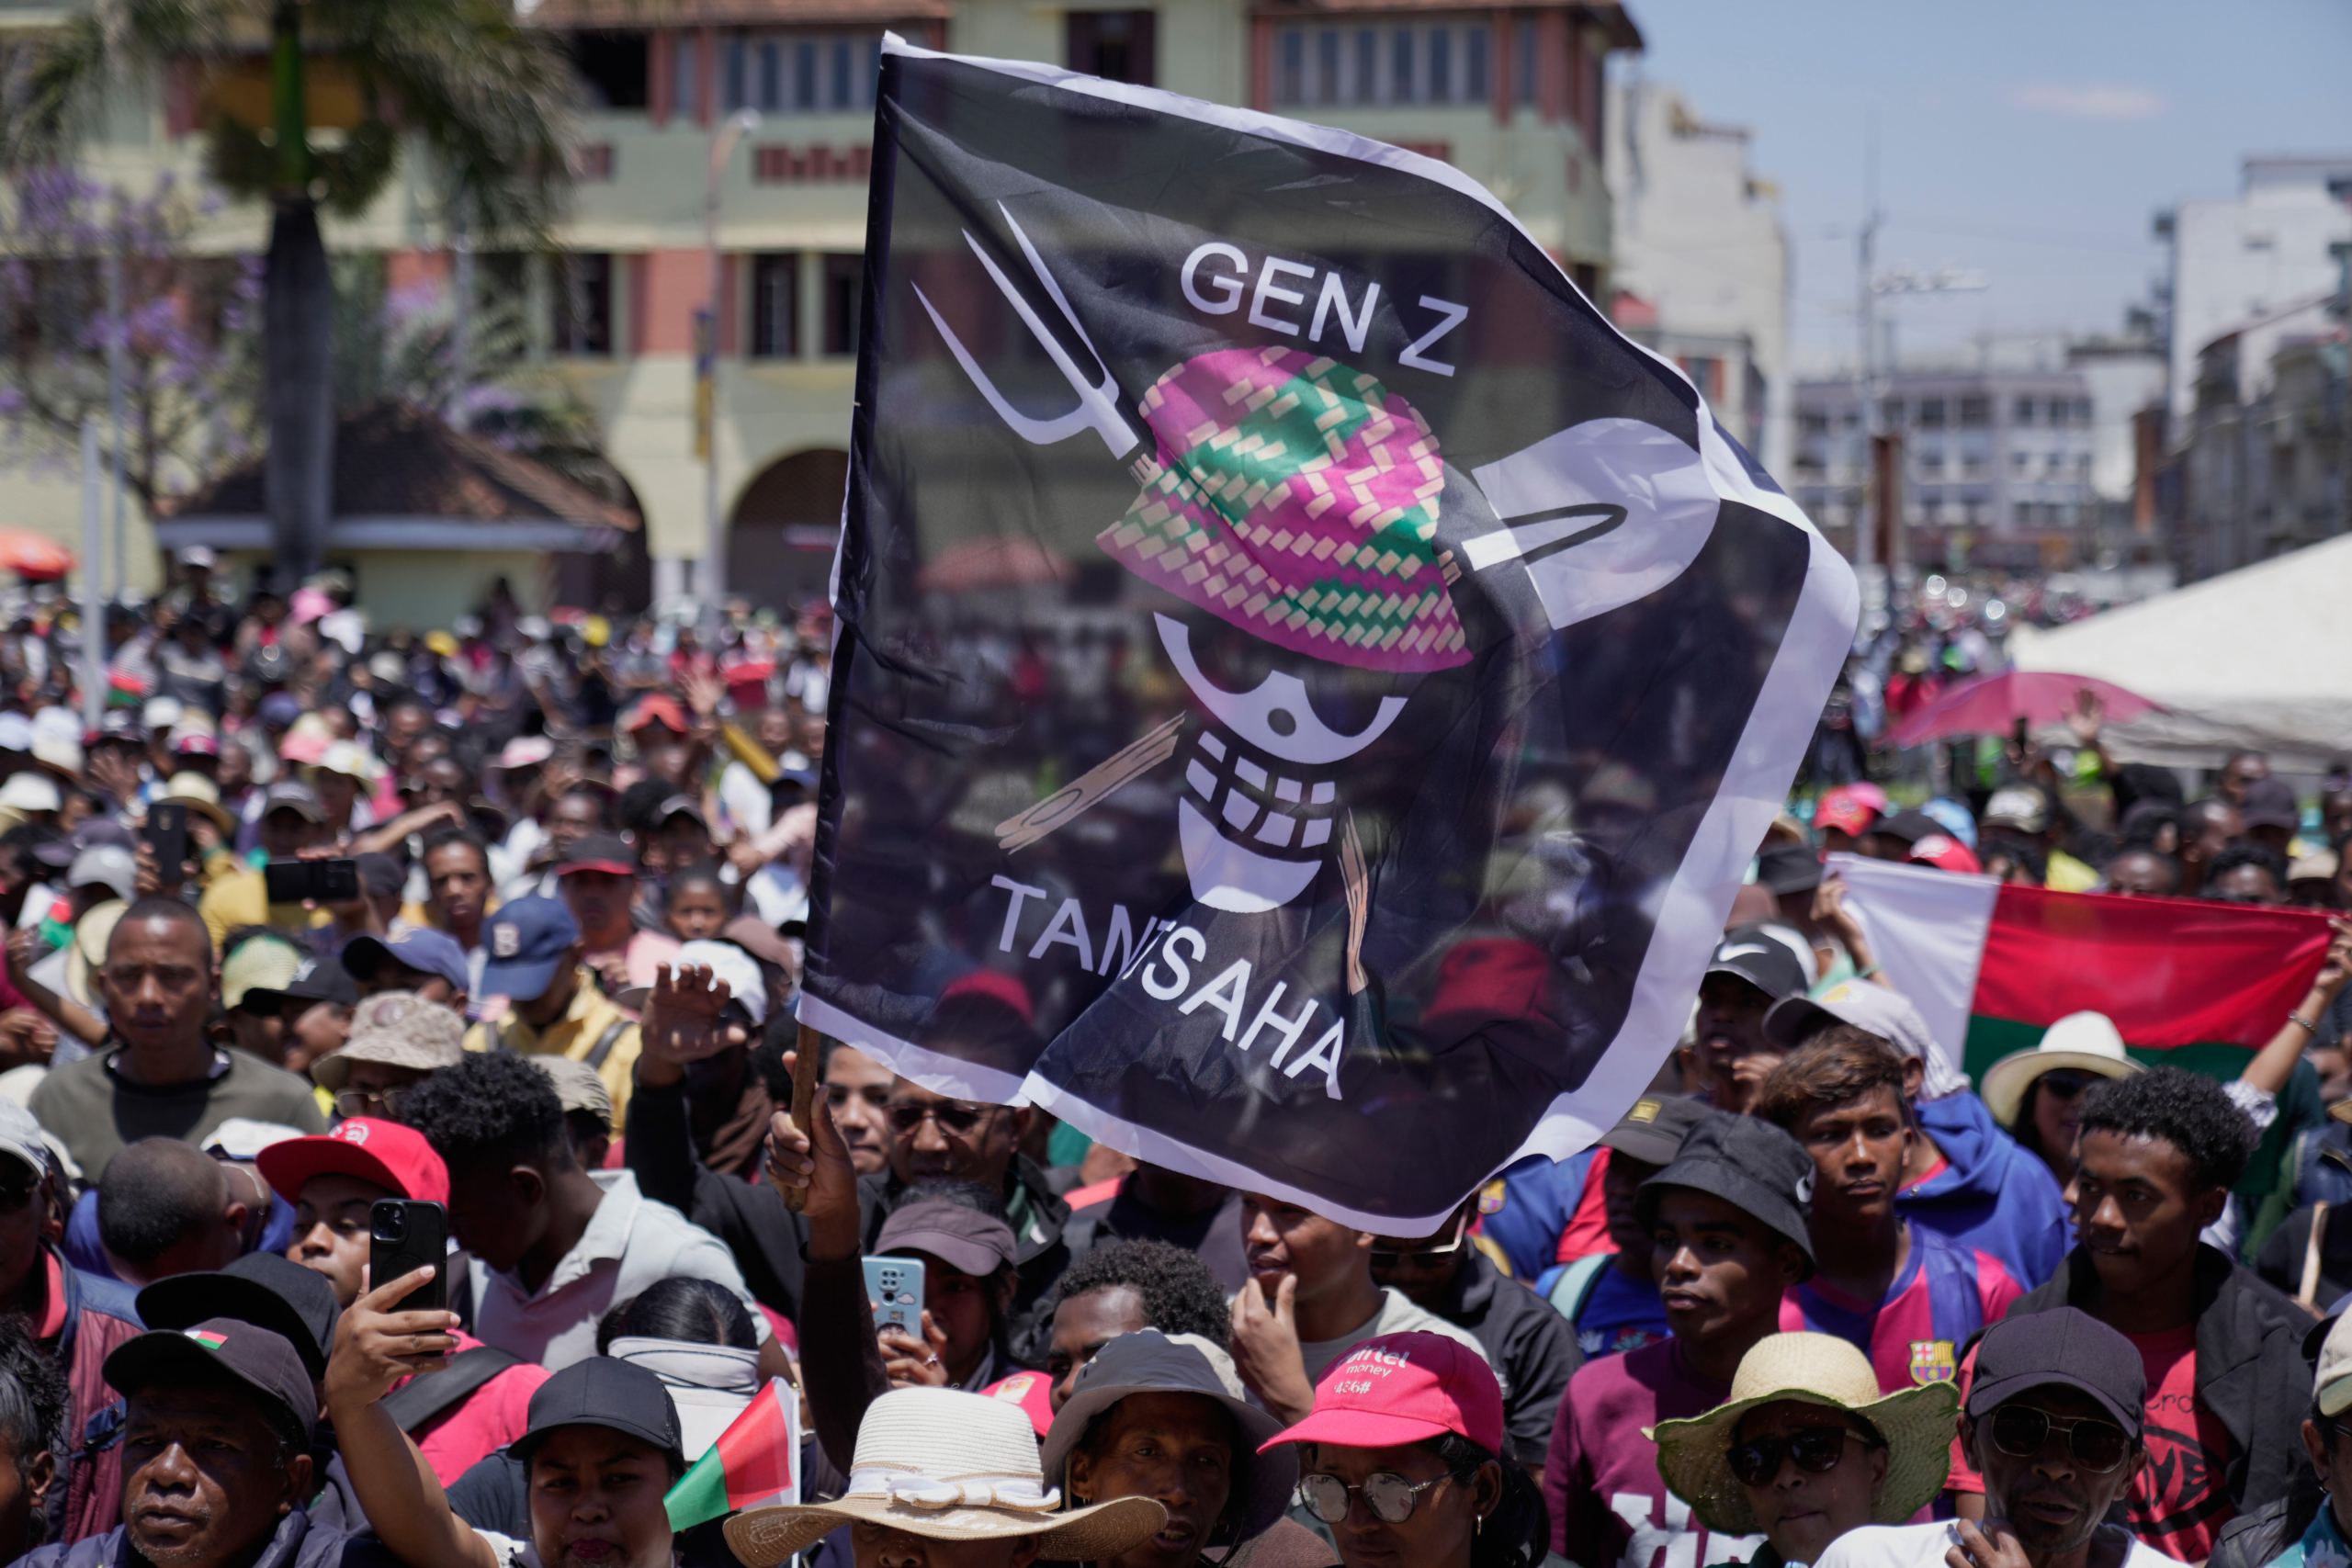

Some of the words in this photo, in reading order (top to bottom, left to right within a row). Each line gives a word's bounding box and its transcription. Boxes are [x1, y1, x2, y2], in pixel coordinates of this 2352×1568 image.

[1181, 242, 1381, 353] GEN
[1398, 296, 1468, 377] Z
[1346, 1346, 1410, 1368] airtel
[1346, 1364, 1392, 1379] money
